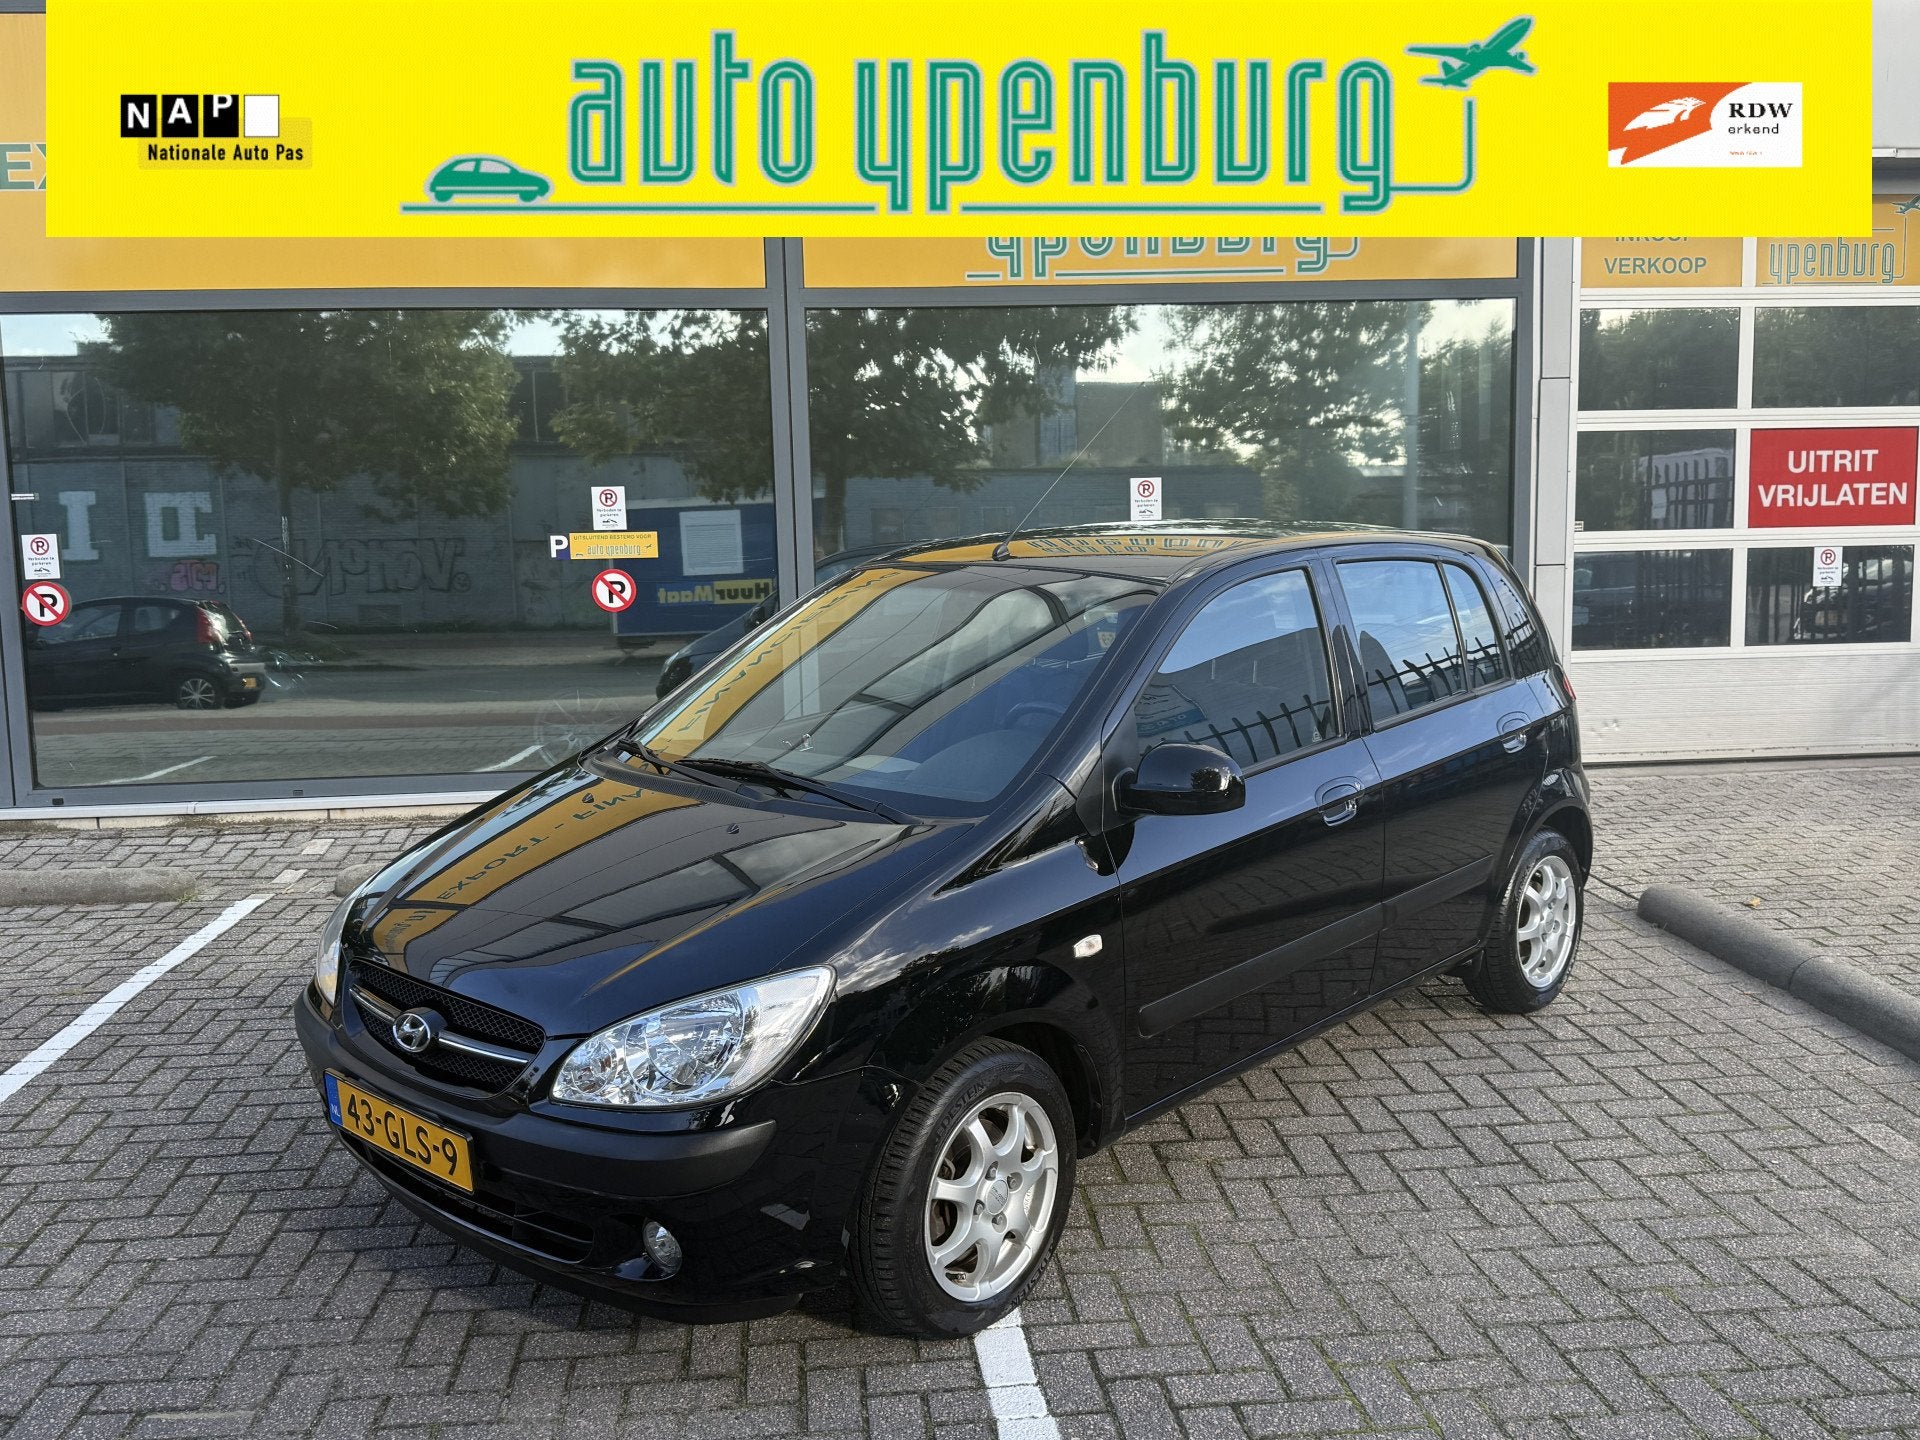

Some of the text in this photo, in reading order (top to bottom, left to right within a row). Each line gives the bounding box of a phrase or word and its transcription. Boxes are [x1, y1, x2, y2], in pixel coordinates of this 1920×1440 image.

[1604, 257, 1707, 275] VERKOOP
[1769, 237, 1896, 284] ypenburg
[1788, 449, 1878, 474] UITRIT
[1757, 482, 1907, 508] VRIJLATEN
[331, 1104, 341, 1117] NL
[347, 1093, 458, 1176] 43-GLS-9
